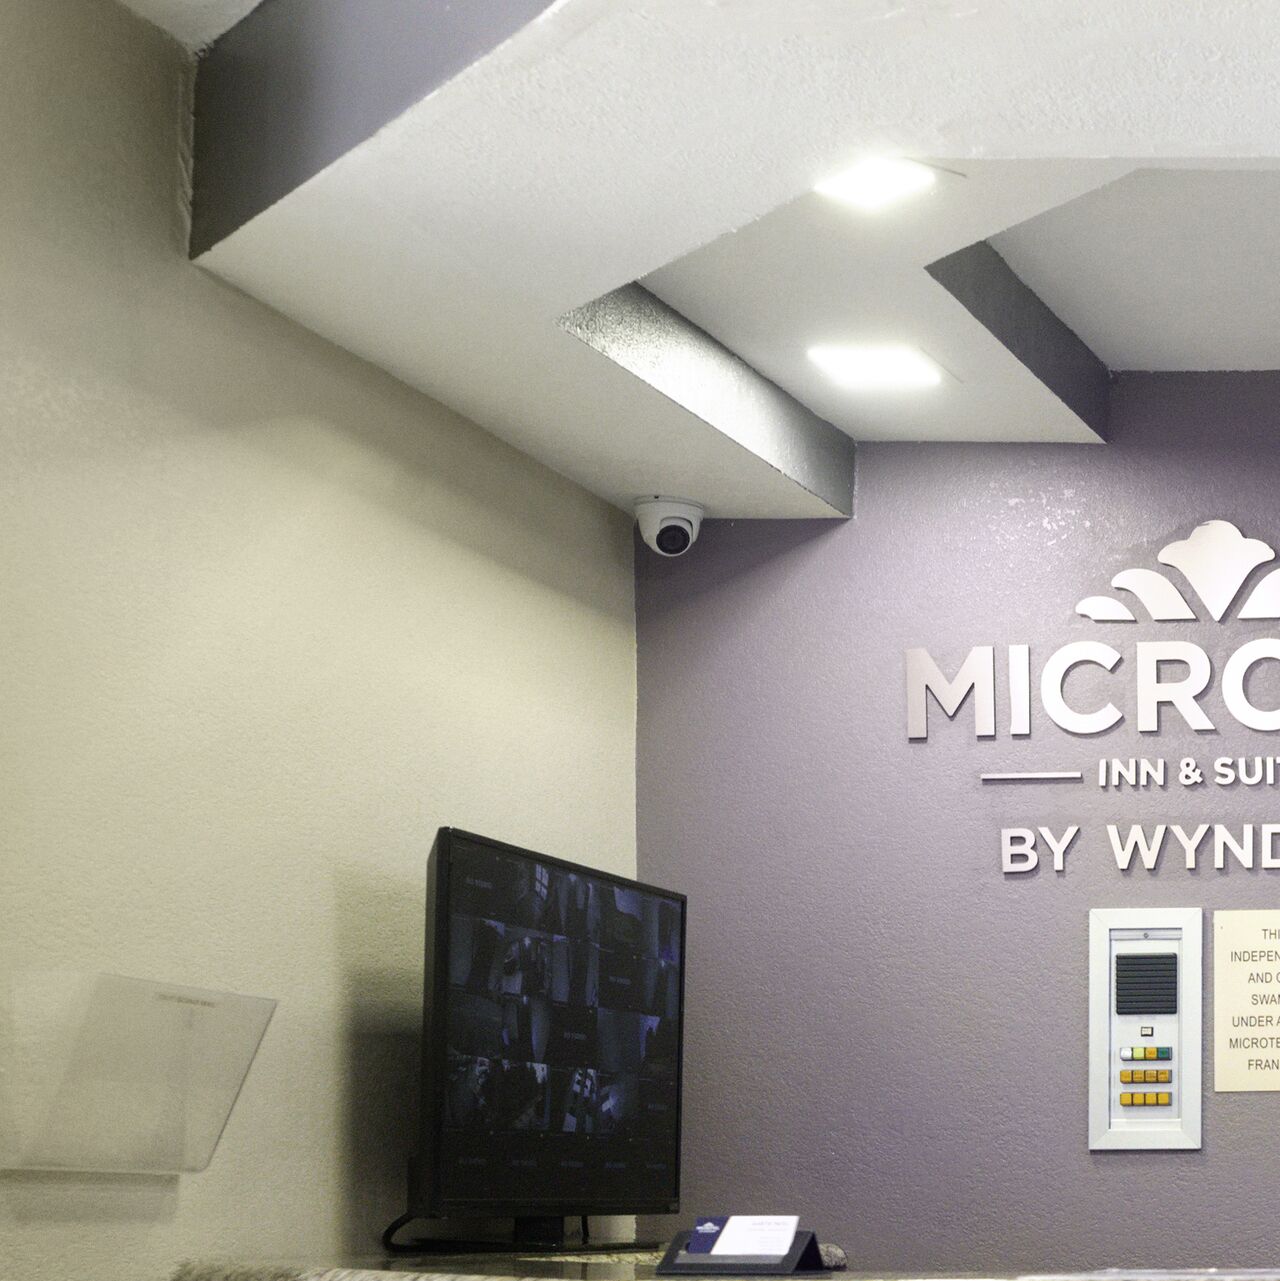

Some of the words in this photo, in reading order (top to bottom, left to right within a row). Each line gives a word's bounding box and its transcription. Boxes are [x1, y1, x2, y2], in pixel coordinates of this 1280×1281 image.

[1098, 757, 1165, 787] INN
[1178, 757, 1203, 786] &
[1000, 825, 1080, 874] BY
[1247, 972, 1273, 984] AND
[1232, 1015, 1274, 1028] UNDER
